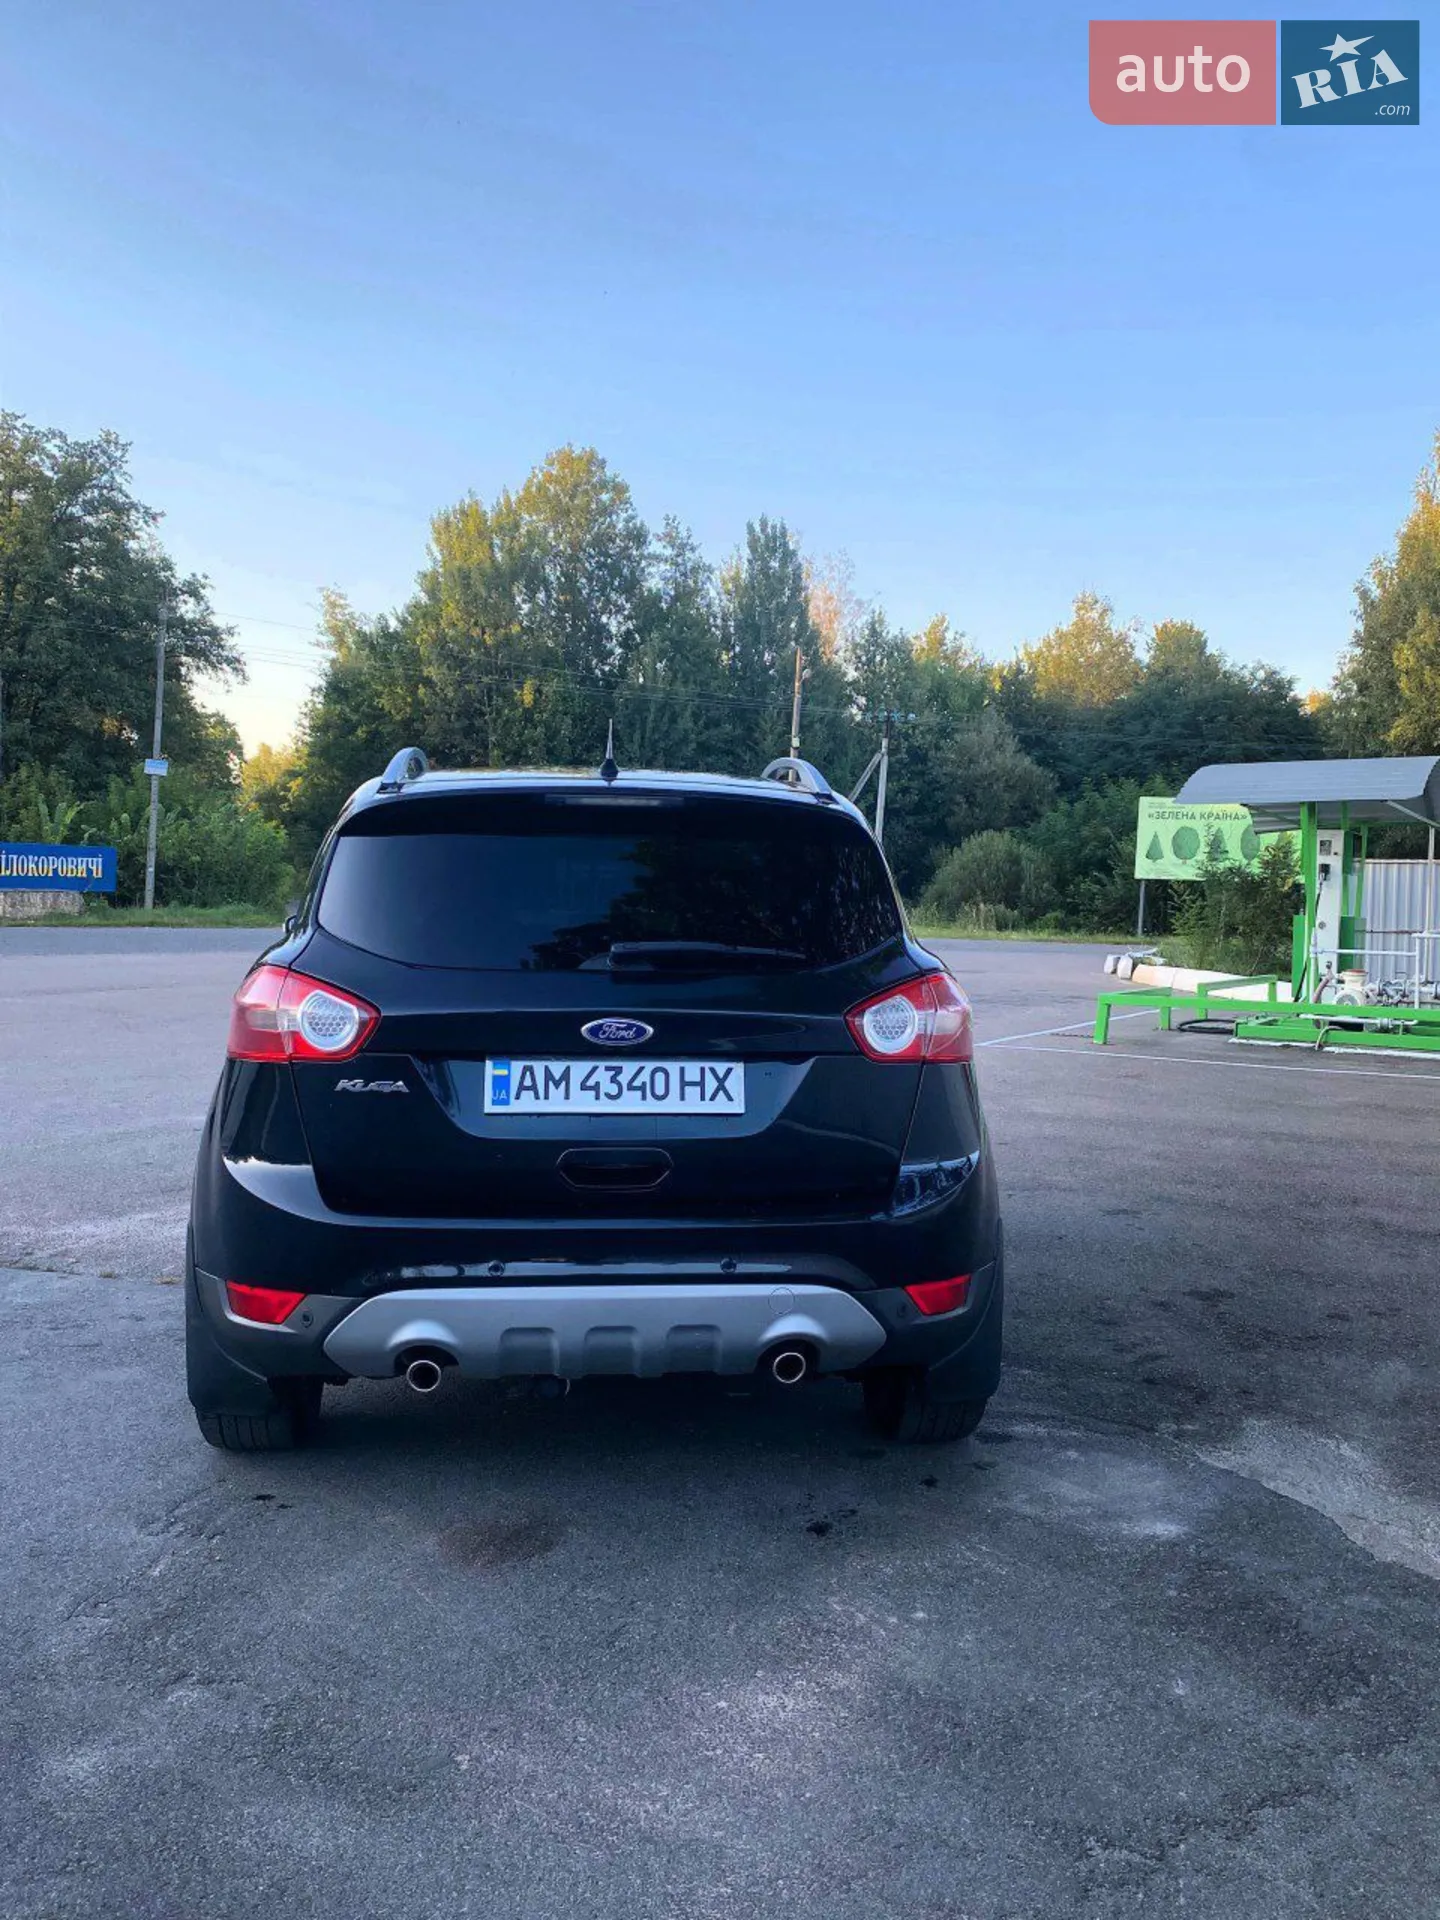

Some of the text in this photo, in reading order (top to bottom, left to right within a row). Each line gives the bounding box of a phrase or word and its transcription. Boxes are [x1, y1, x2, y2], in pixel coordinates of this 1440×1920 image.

[1147, 809, 1248, 821] «ЗЕЛЕНА КРАЇНА»
[598, 1022, 637, 1039] Ford
[334, 1079, 410, 1093] KUGA
[514, 1064, 735, 1102] AM 4340 HX
